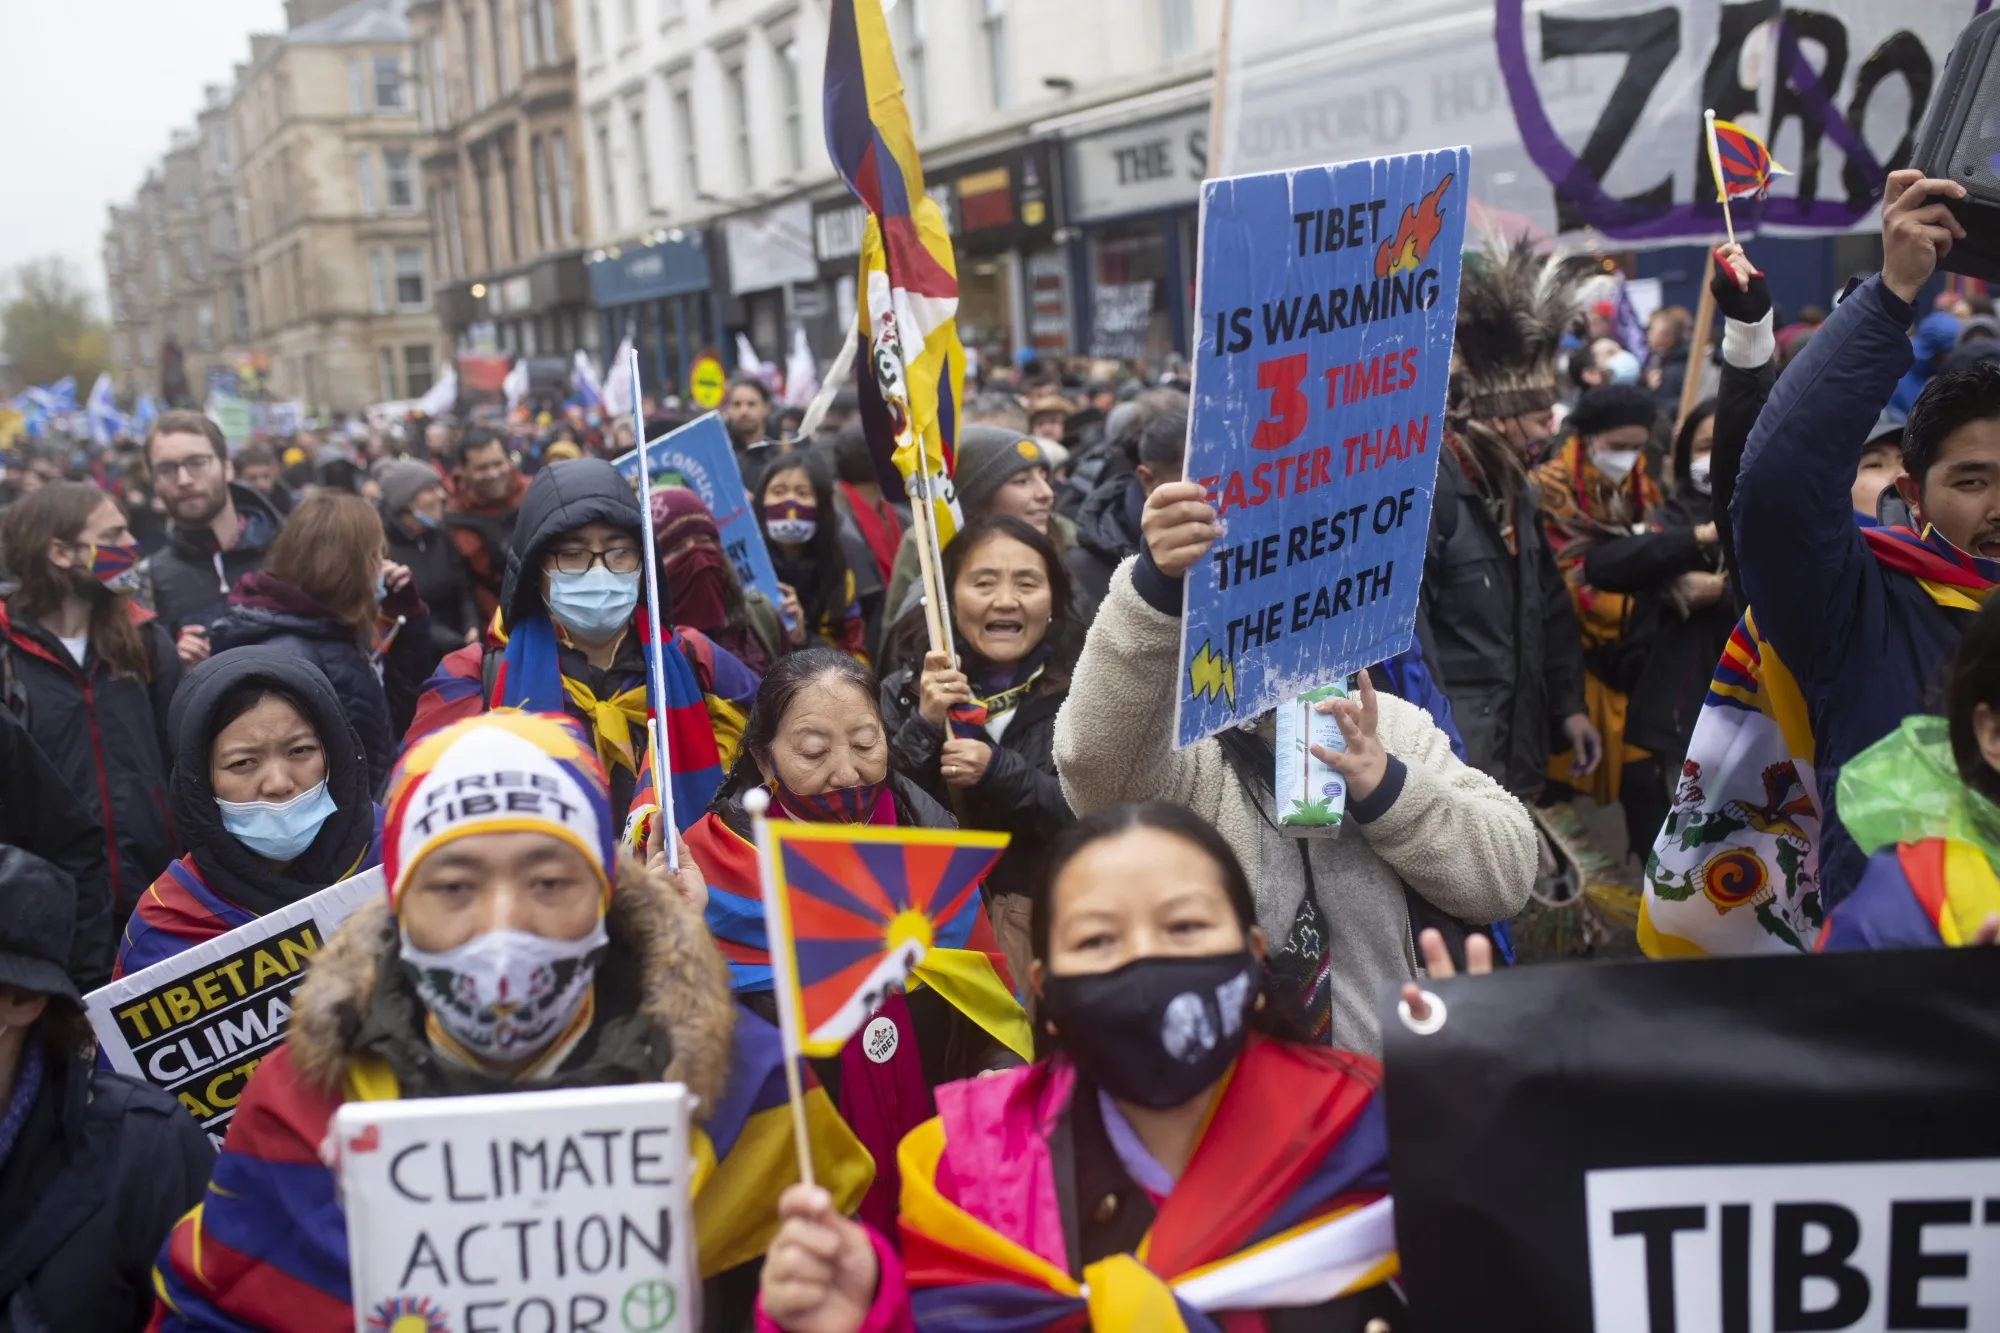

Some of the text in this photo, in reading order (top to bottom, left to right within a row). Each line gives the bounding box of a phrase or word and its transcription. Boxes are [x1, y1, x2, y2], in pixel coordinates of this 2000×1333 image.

[1111, 138, 1173, 186] THE
[1294, 199, 1386, 257] TIBET
[1215, 307, 1253, 357] IS
[1262, 269, 1440, 345] WARMING
[1252, 347, 1418, 450] 3 TIMES
[1343, 416, 1428, 476] THAN
[1214, 488, 1415, 591] THE REST OF
[1227, 561, 1393, 659] THE EARTH
[413, 792, 578, 834] TIBET
[426, 770, 559, 807] FREE
[119, 929, 318, 1040] TIBETAN
[149, 985, 302, 1081] CLIMA
[875, 1034, 896, 1059] TIBET
[388, 1126, 672, 1202] CLIMATE
[400, 1207, 672, 1290] ACTION
[1611, 1196, 2000, 1333] TIBE
[465, 1293, 608, 1333] FOR
